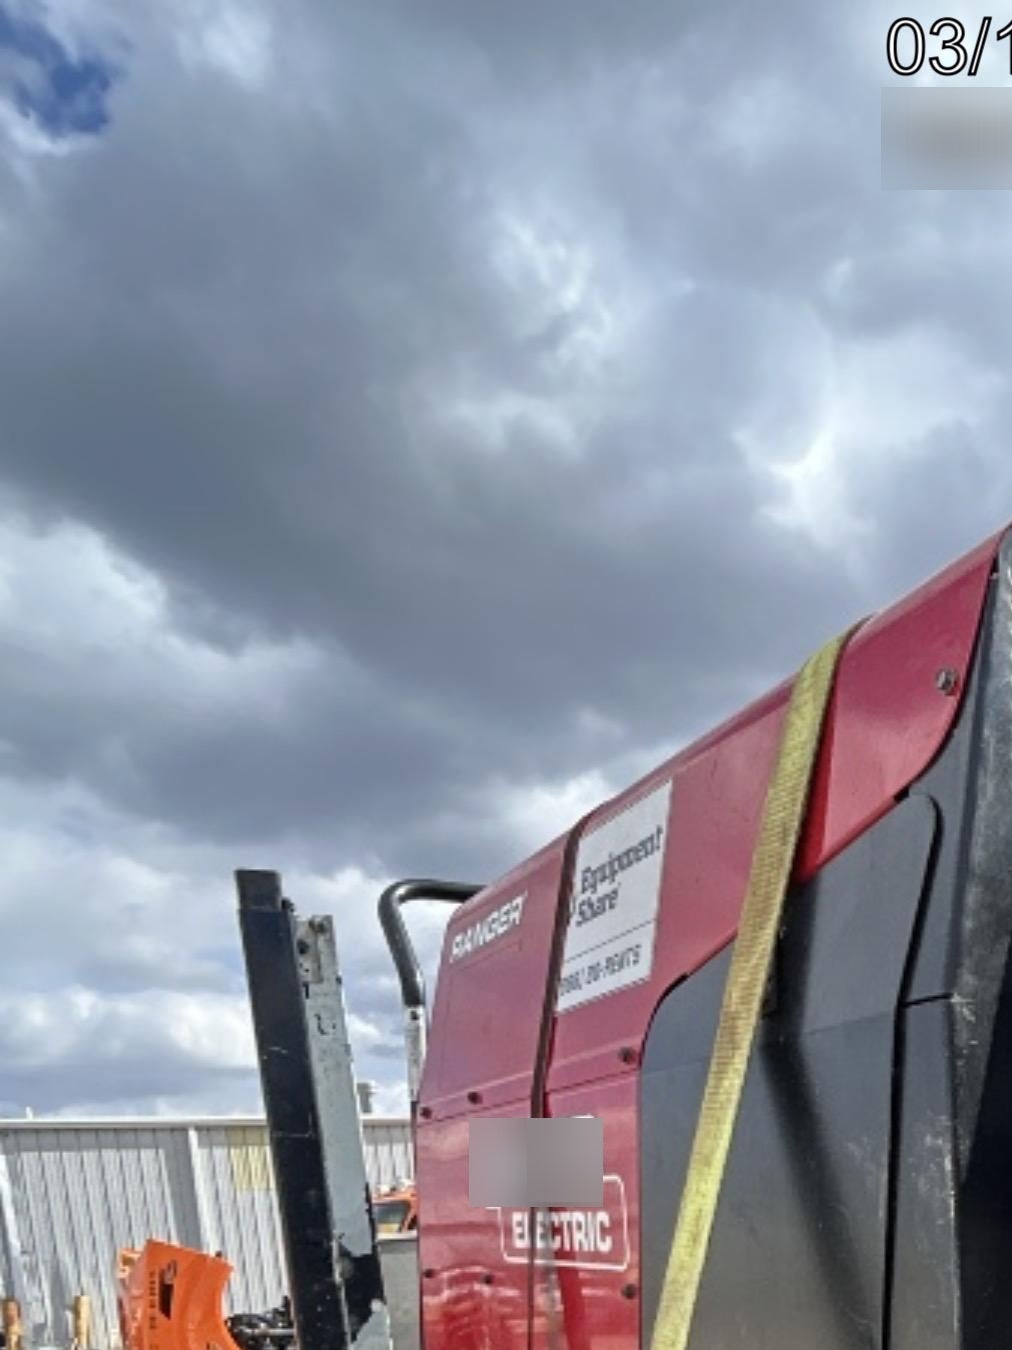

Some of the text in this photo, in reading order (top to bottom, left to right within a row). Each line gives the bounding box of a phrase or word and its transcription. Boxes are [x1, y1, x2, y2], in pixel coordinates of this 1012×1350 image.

[581, 825, 663, 894] Equipment
[452, 894, 524, 958] RANGER
[576, 887, 619, 928] Share
[512, 1211, 613, 1254] ELECTRIC
